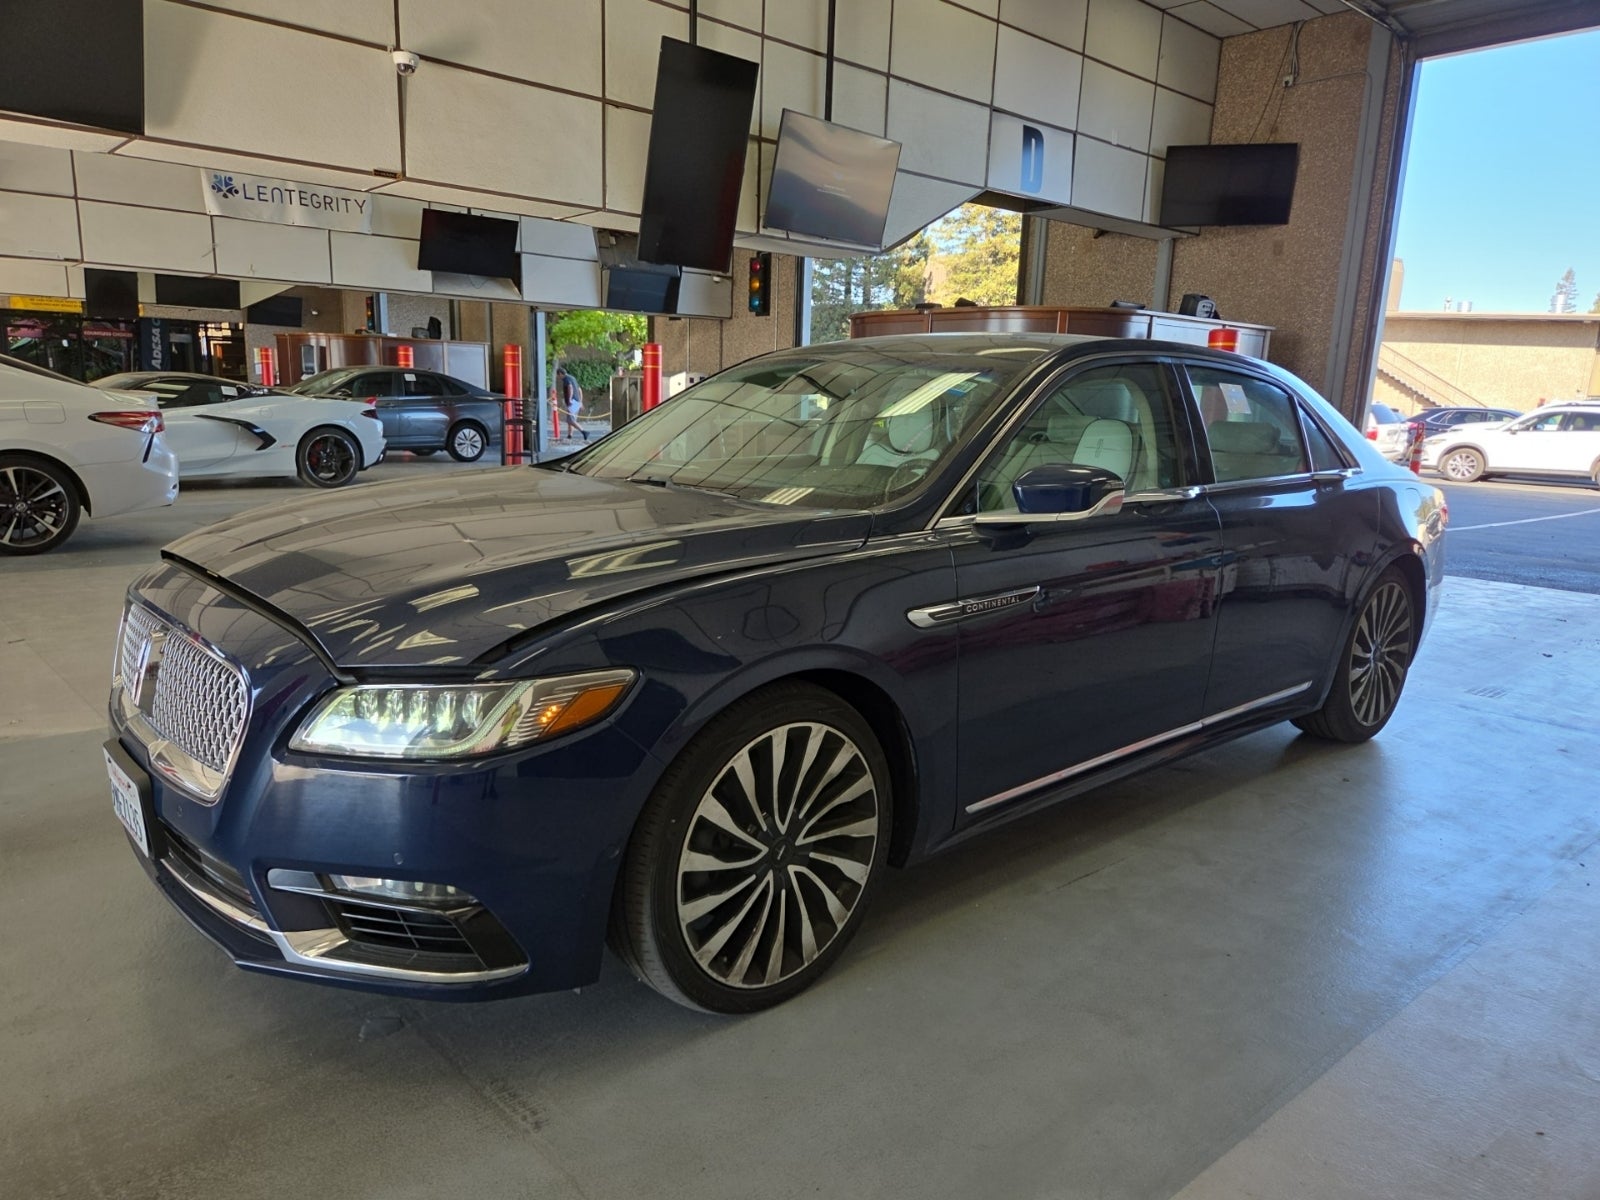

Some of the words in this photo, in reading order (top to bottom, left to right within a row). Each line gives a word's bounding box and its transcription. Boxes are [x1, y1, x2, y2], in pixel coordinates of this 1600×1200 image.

[1021, 124, 1044, 193] D
[242, 183, 366, 214] LENTEGRITY
[151, 326, 162, 370] ADESA
[966, 596, 1020, 612] CONTINENTAL
